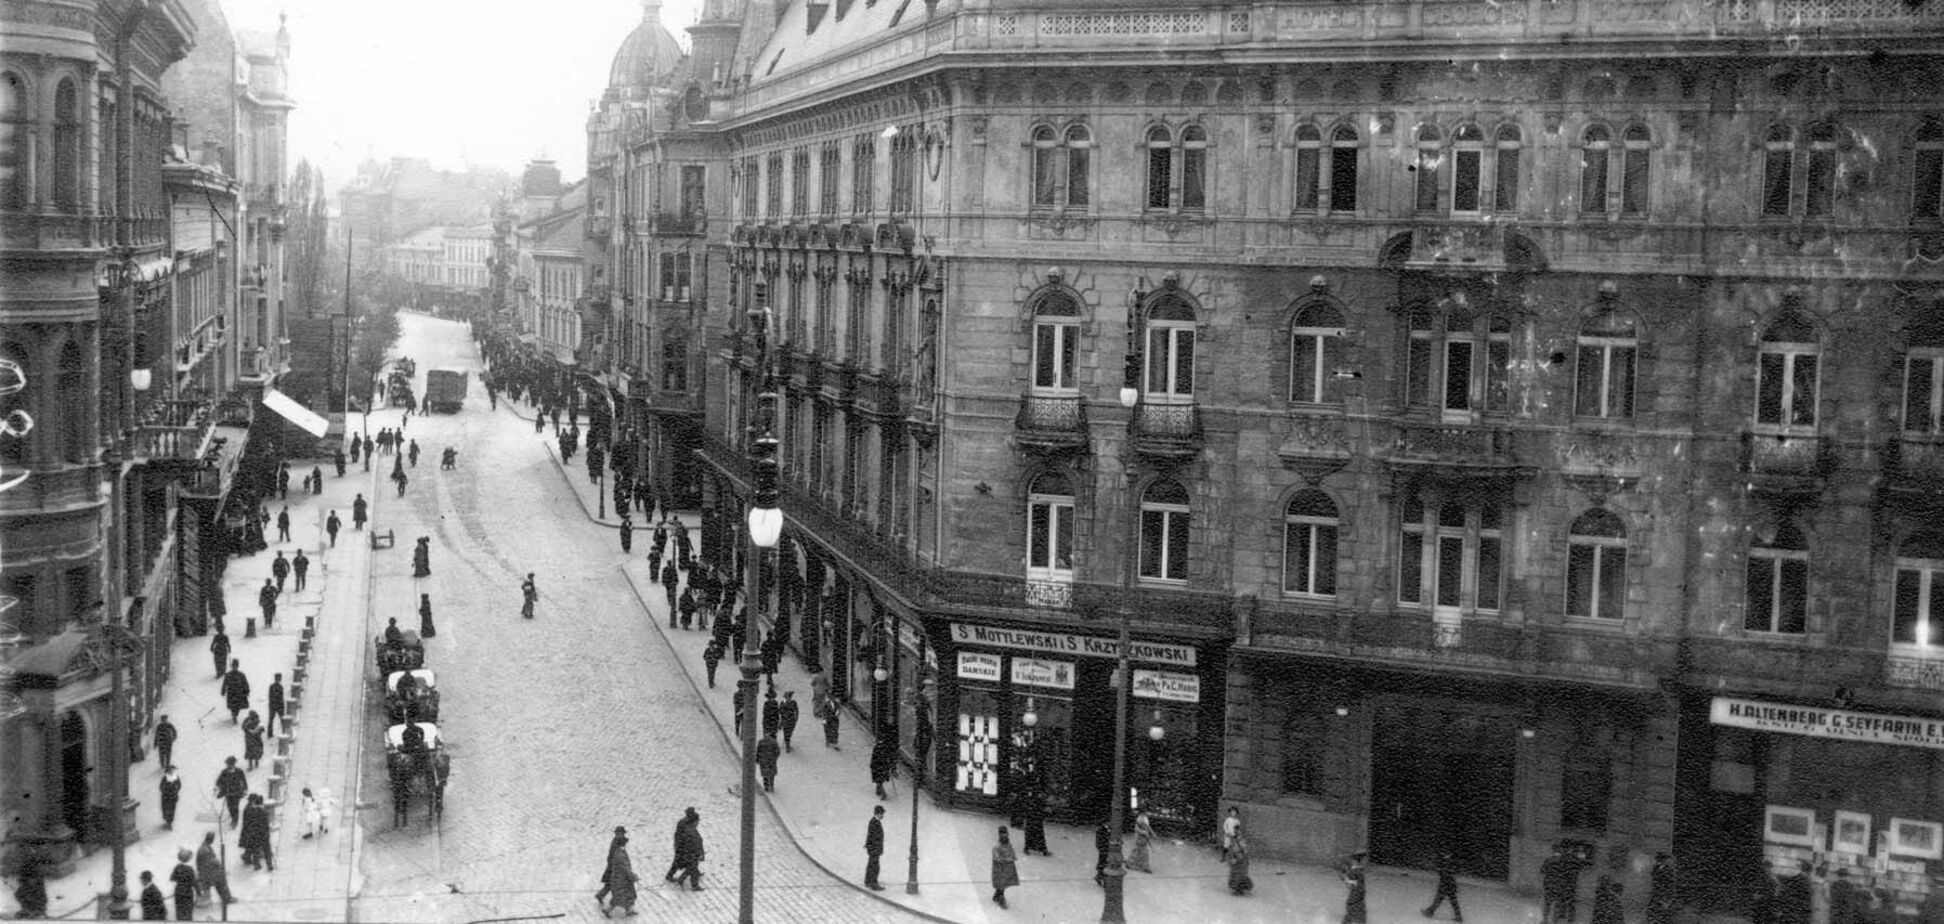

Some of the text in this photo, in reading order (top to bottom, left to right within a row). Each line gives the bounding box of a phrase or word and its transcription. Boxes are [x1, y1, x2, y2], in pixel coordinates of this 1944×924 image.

[1083, 636, 1188, 661] KRZYZKOWSKI
[1745, 705, 1827, 726] ALTENBERG
[1846, 716, 1922, 735] SEYFARTH
